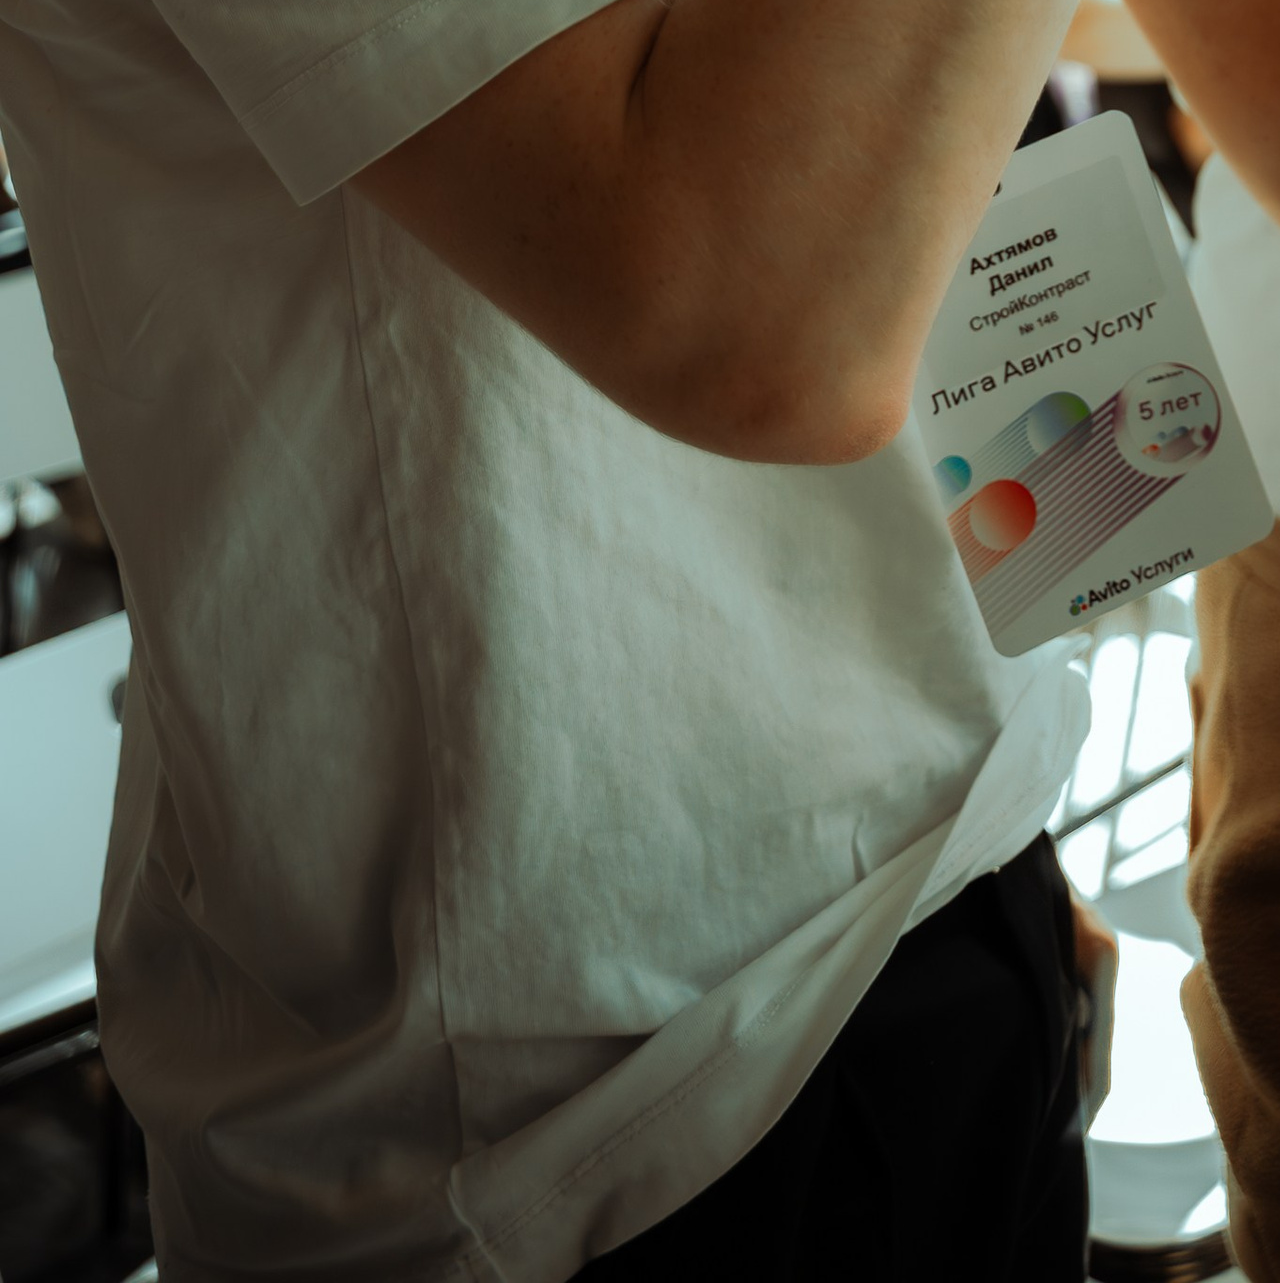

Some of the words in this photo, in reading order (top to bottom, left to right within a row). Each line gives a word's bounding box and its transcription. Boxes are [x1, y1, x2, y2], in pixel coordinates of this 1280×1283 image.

[970, 228, 1058, 275] Ахтямов
[989, 256, 1054, 296] Данил
[969, 270, 1091, 332] СтройКонтраст
[931, 374, 998, 415] Лига
[1003, 337, 1082, 383] Авито
[1083, 301, 1158, 345] Услуг
[1138, 400, 1155, 422] 5
[1160, 391, 1203, 417] лет
[1088, 579, 1131, 607] Avito
[1130, 547, 1194, 584] Услуги
